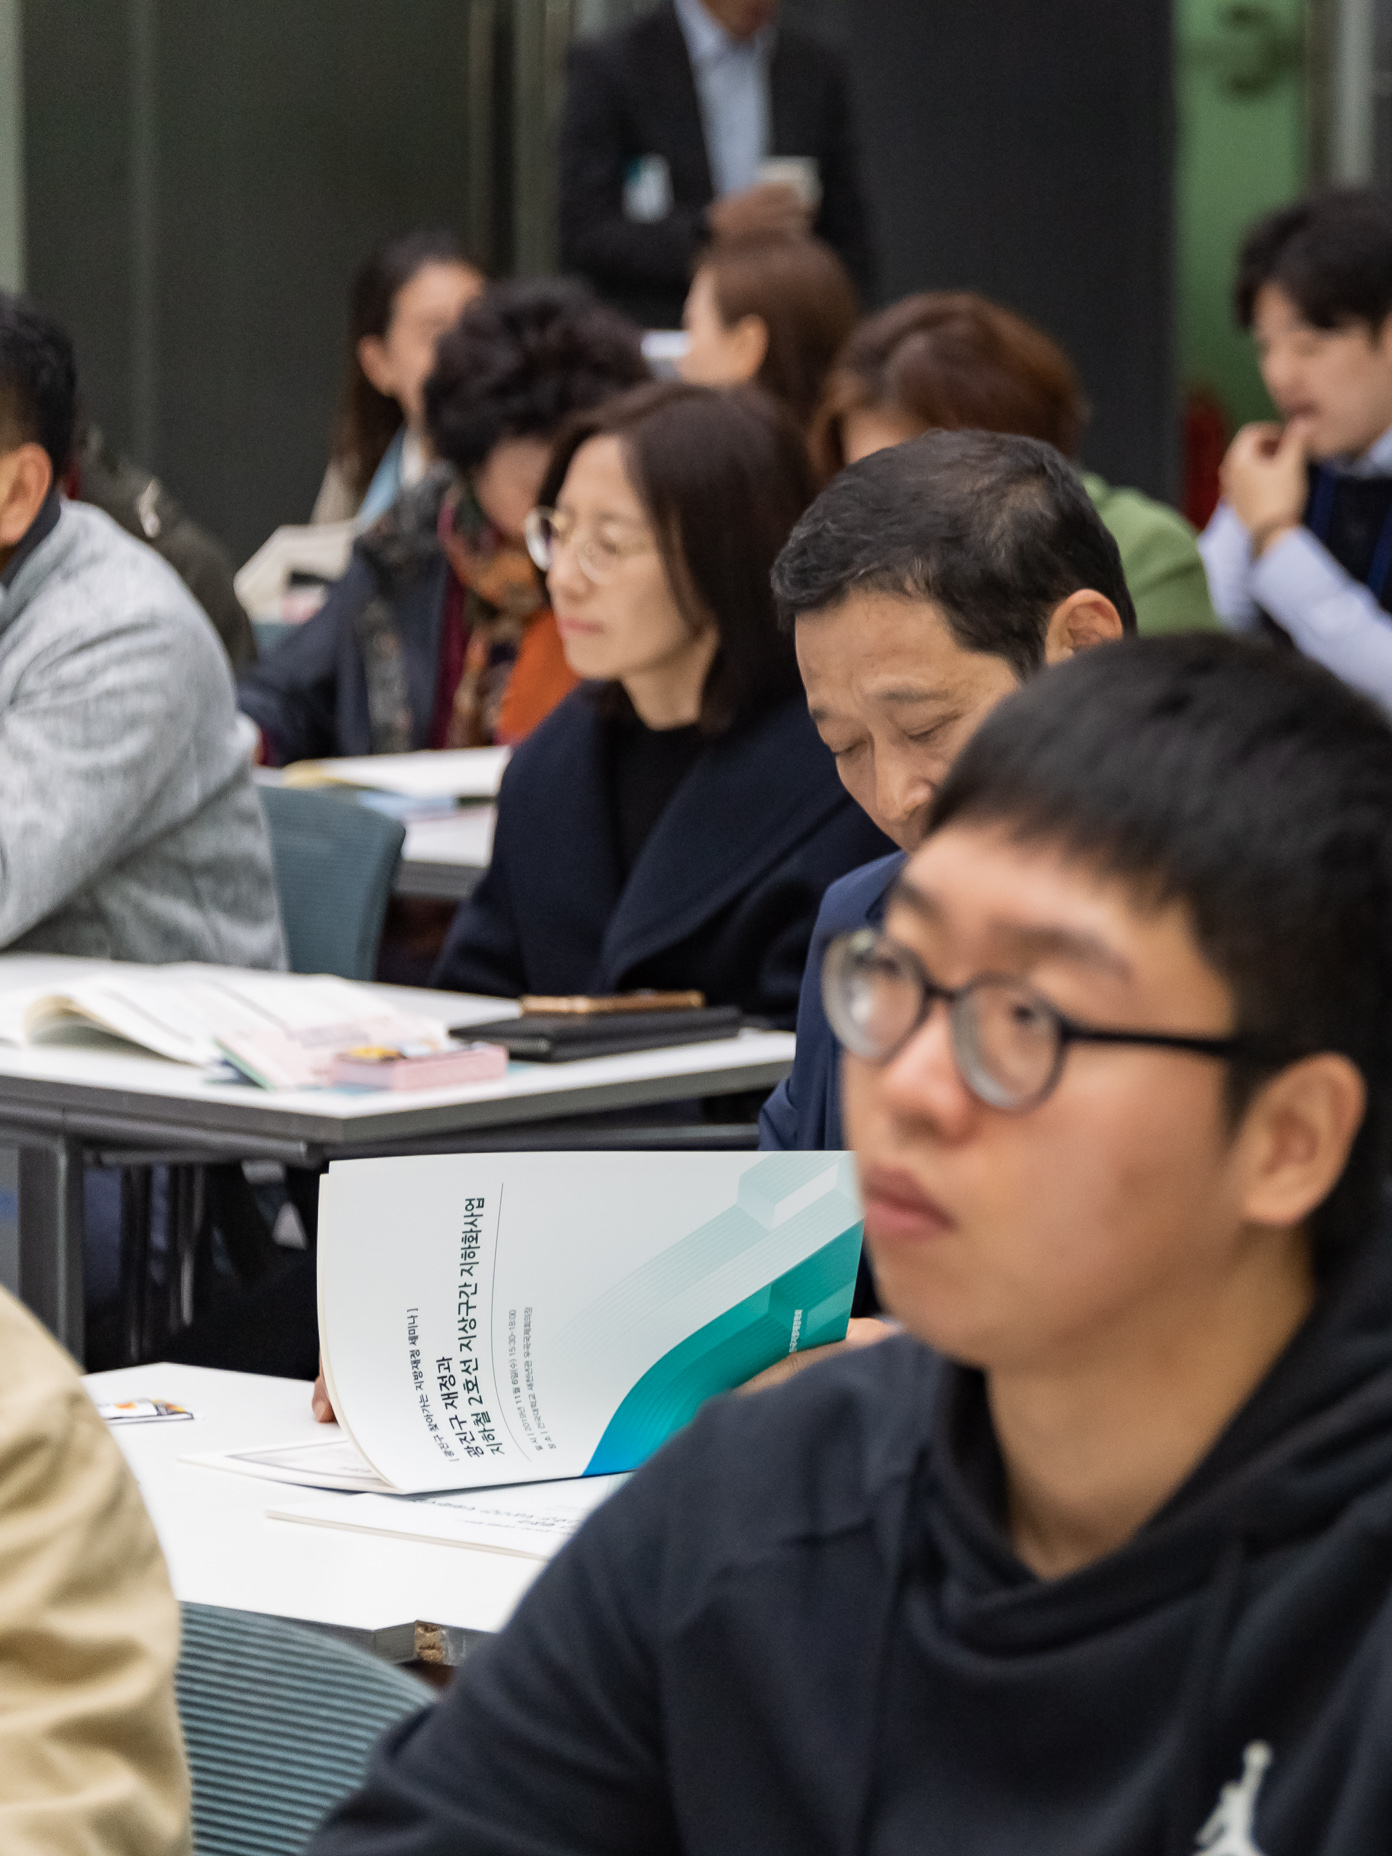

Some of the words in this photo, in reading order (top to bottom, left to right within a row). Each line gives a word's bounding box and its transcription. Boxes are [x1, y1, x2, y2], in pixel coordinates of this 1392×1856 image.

[459, 1197, 485, 1277] 지하화사업
[407, 1315, 419, 1346] 세미나
[457, 1282, 478, 1352] 지상구간
[409, 1349, 425, 1391] 지방재정
[436, 1356, 459, 1410] 재정과
[460, 1357, 484, 1406] 2호선
[419, 1394, 439, 1432] 찾아가는
[473, 1410, 505, 1456] 지하철
[449, 1414, 485, 1459] 광진구
